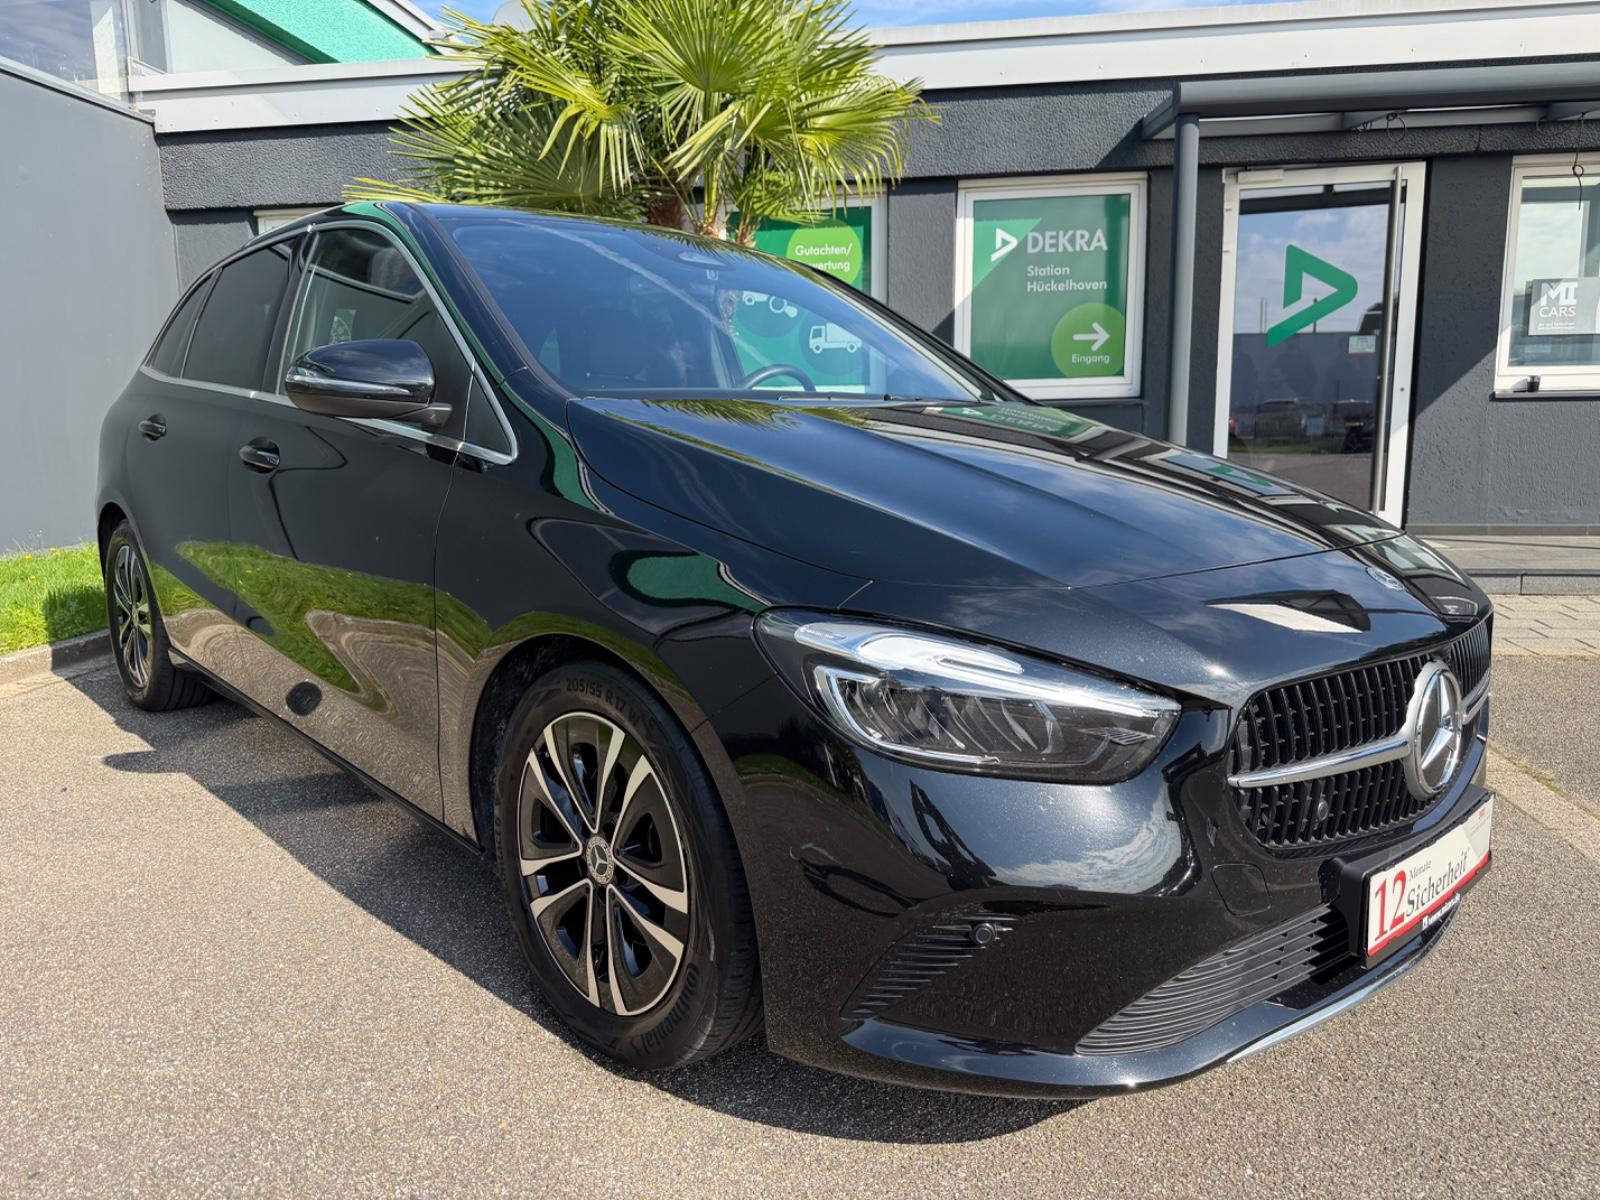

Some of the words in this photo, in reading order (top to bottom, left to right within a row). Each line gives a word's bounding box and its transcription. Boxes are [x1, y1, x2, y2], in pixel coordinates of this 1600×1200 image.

[1027, 228, 1108, 253] DEKRA
[795, 243, 852, 256] Gutachten/
[1027, 264, 1070, 277] Station
[1027, 279, 1107, 292] Hückelhoven
[1540, 306, 1576, 318] CARS
[1072, 353, 1110, 365] Eingang
[567, 678, 602, 698] 205/55
[1375, 870, 1407, 942] 12
[640, 962, 700, 1055] Continental
